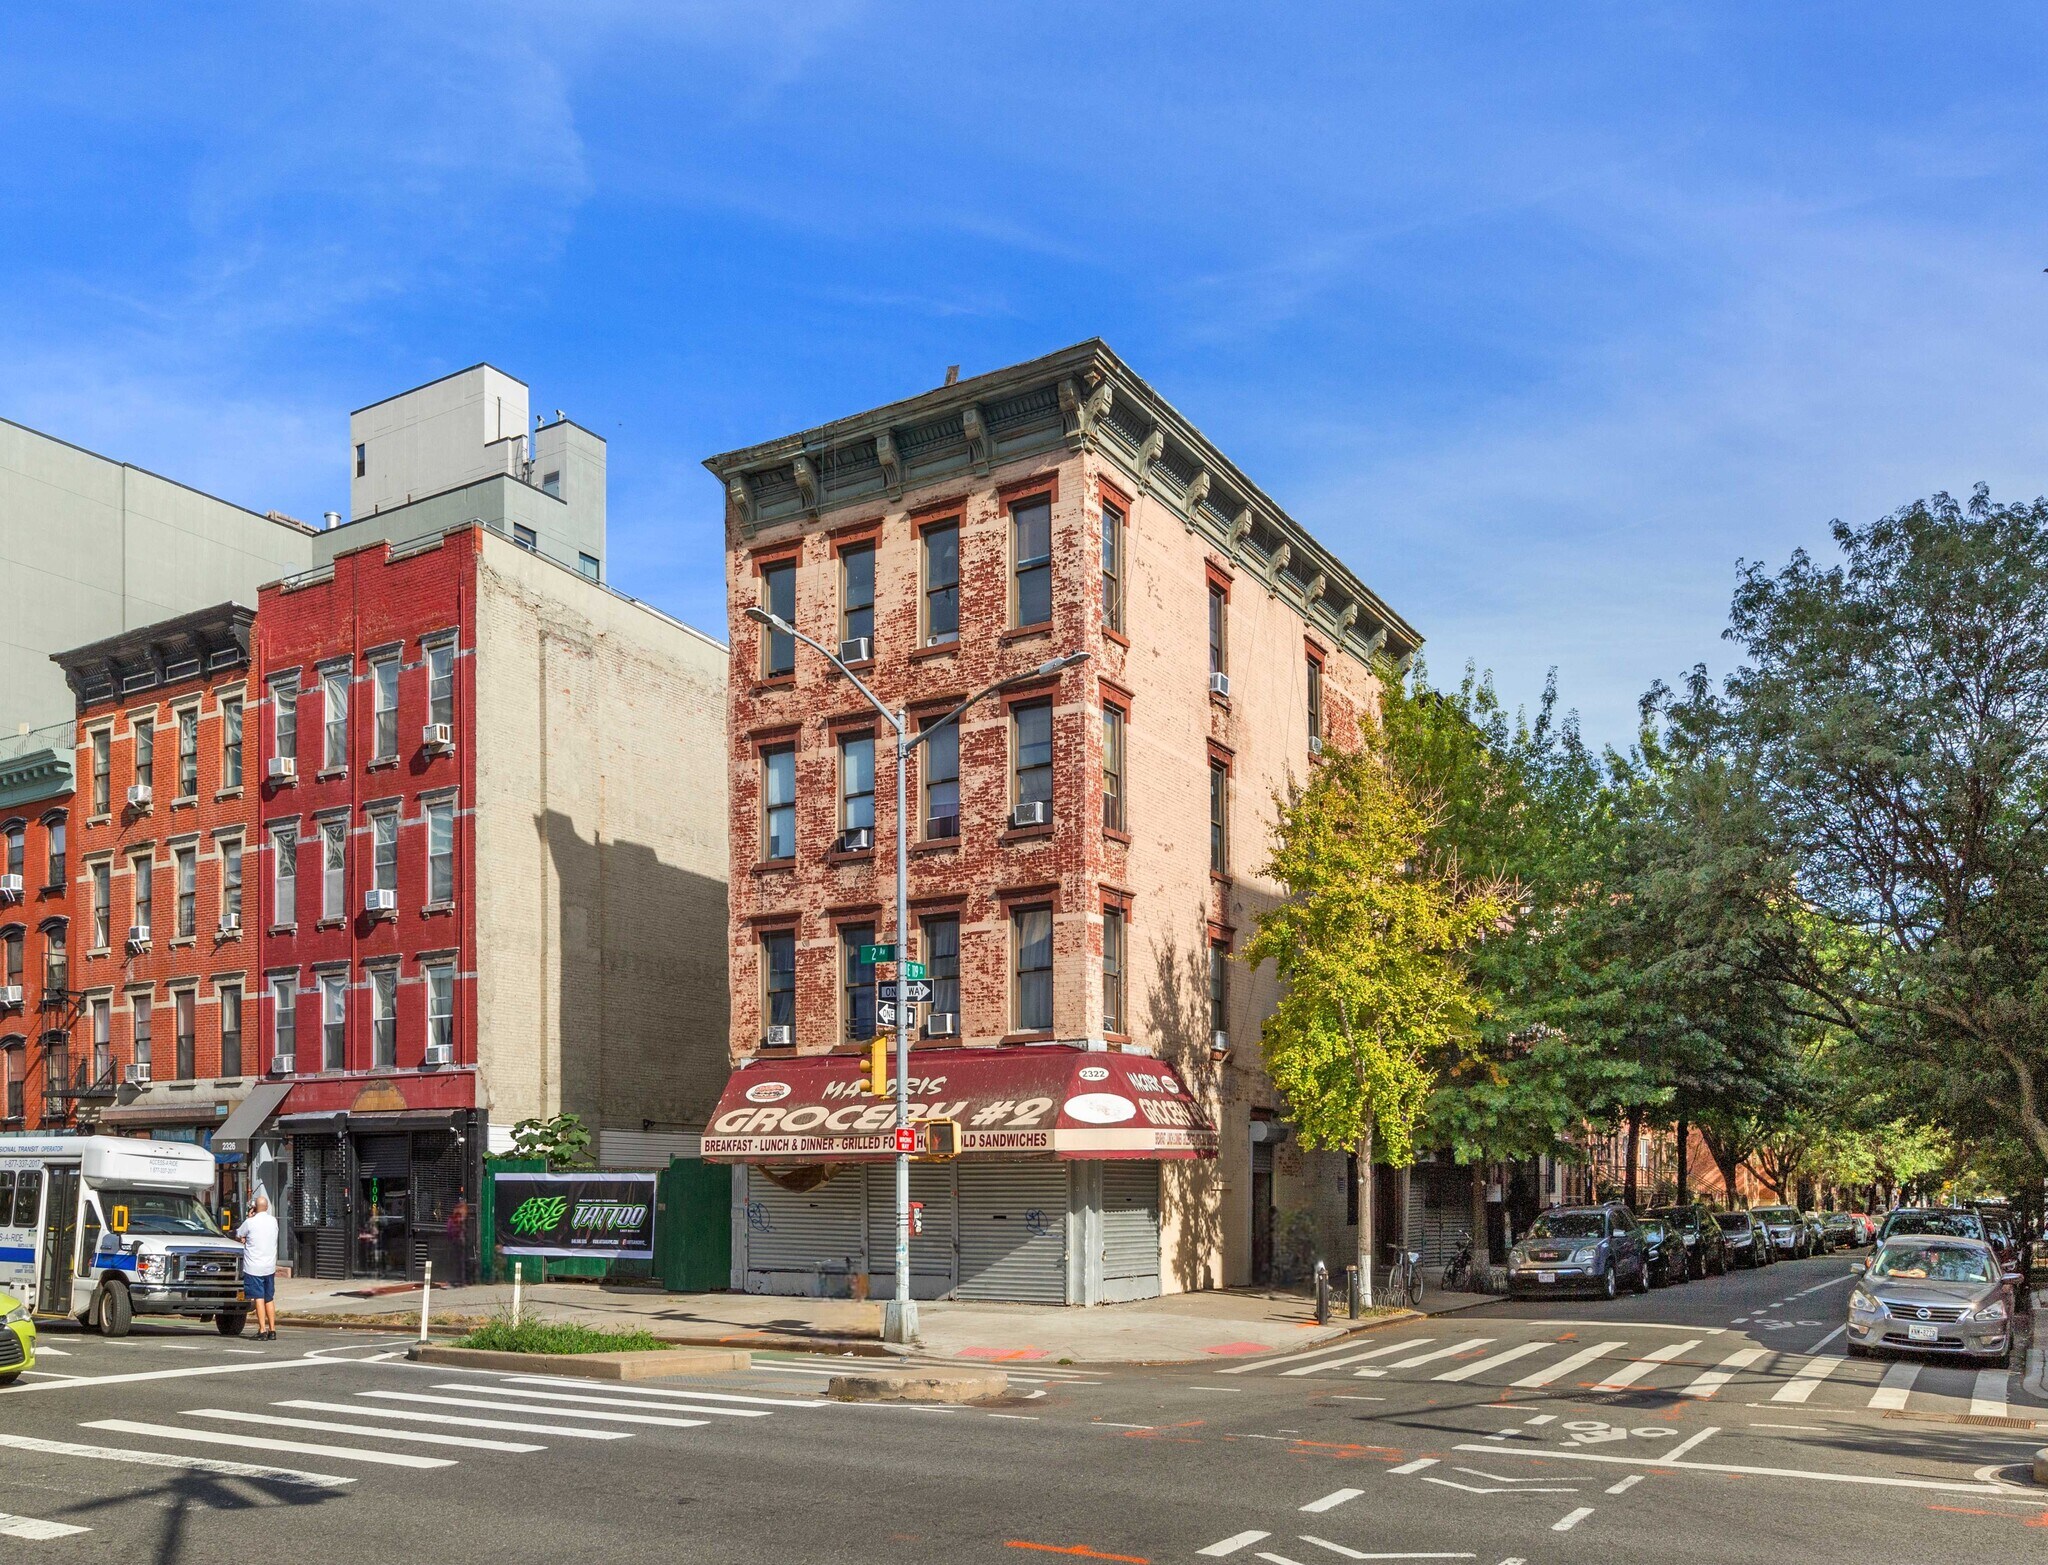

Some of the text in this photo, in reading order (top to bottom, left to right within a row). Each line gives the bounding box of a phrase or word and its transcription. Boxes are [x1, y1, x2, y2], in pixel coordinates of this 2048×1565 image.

[871, 947, 877, 961] 2
[907, 963, 911, 977] E
[885, 987, 925, 997] ON WAY
[882, 1008, 894, 1019] ONE
[1082, 1070, 1106, 1078] 2322
[821, 1076, 948, 1100] MAORIS
[714, 1097, 1053, 1133] GROCERY #2
[1138, 1097, 1194, 1127] GROCERY
[705, 1139, 753, 1152] BREAKFAST
[760, 1138, 789, 1151] LUNCH
[791, 1138, 798, 1151] &
[801, 1137, 834, 1151] DINNER
[842, 1136, 880, 1150] GRILLED
[979, 1132, 1047, 1148] SANDWICHES
[572, 1205, 648, 1230] TATTOO
